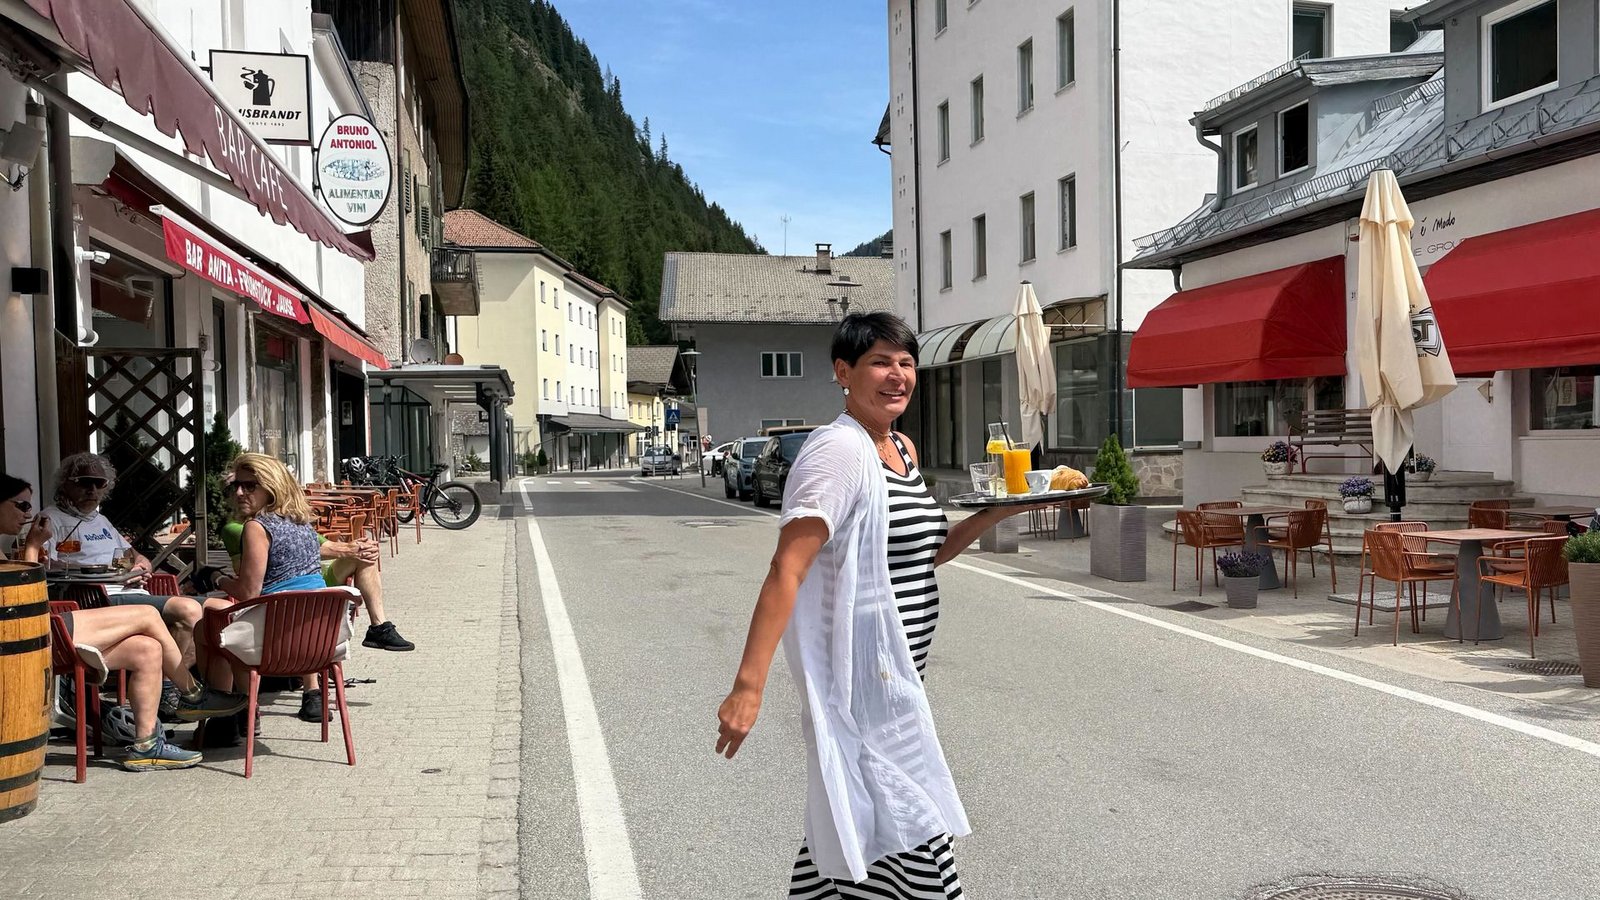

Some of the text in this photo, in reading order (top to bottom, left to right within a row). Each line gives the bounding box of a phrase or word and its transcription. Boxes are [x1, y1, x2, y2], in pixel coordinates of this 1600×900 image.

[337, 125, 369, 136] BRUNO
[214, 104, 249, 178] BAR
[330, 138, 378, 150] ANTONIOL
[328, 188, 384, 200] ALIMENTARI
[347, 202, 367, 214] VINI
[185, 238, 203, 272] BAR
[208, 252, 234, 287] ANITA
[276, 292, 296, 318] JAUSE
